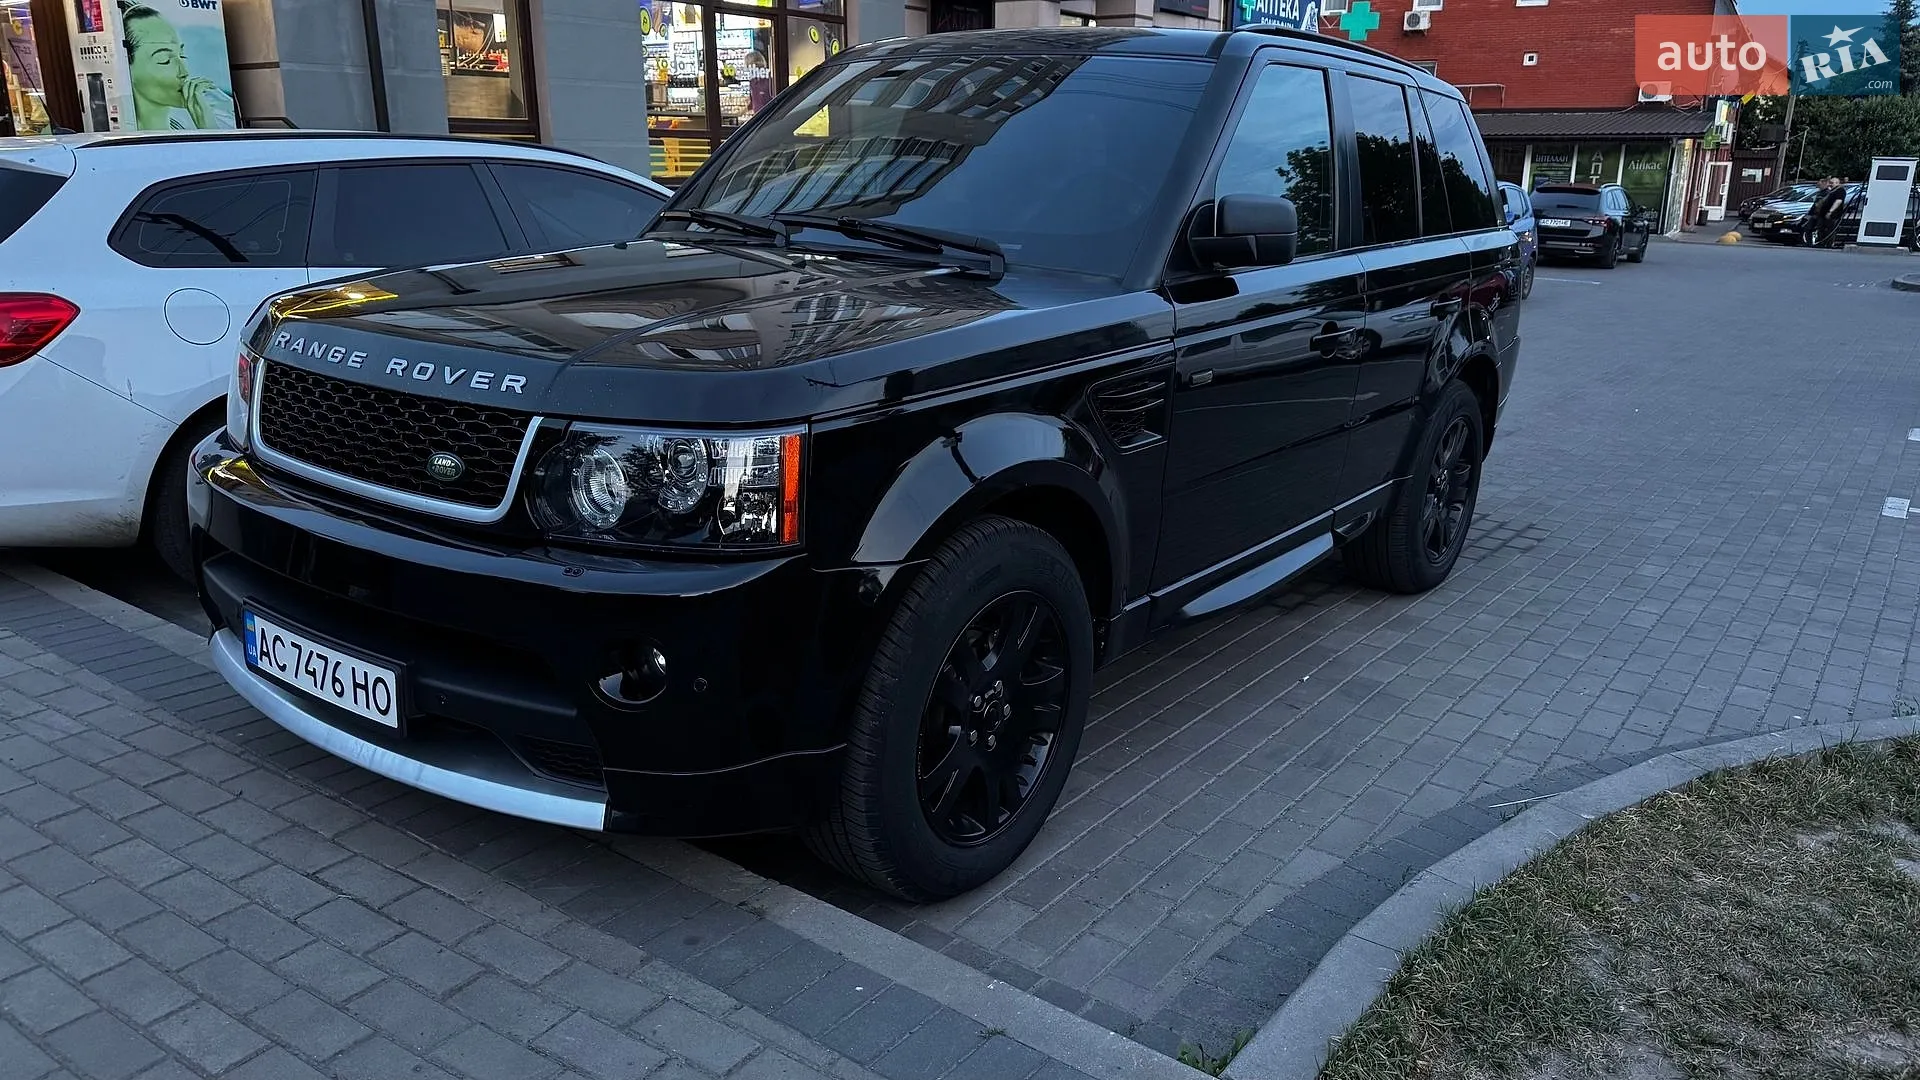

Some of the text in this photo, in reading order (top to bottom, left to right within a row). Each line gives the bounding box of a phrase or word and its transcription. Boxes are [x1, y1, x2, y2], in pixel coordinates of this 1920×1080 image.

[191, 0, 217, 10] BWT
[1256, 0, 1300, 21] АПТЕКА
[274, 330, 528, 395] RANGE ROVER
[434, 457, 452, 467] LAND
[434, 464, 456, 477] ROVER
[247, 643, 257, 658] UA
